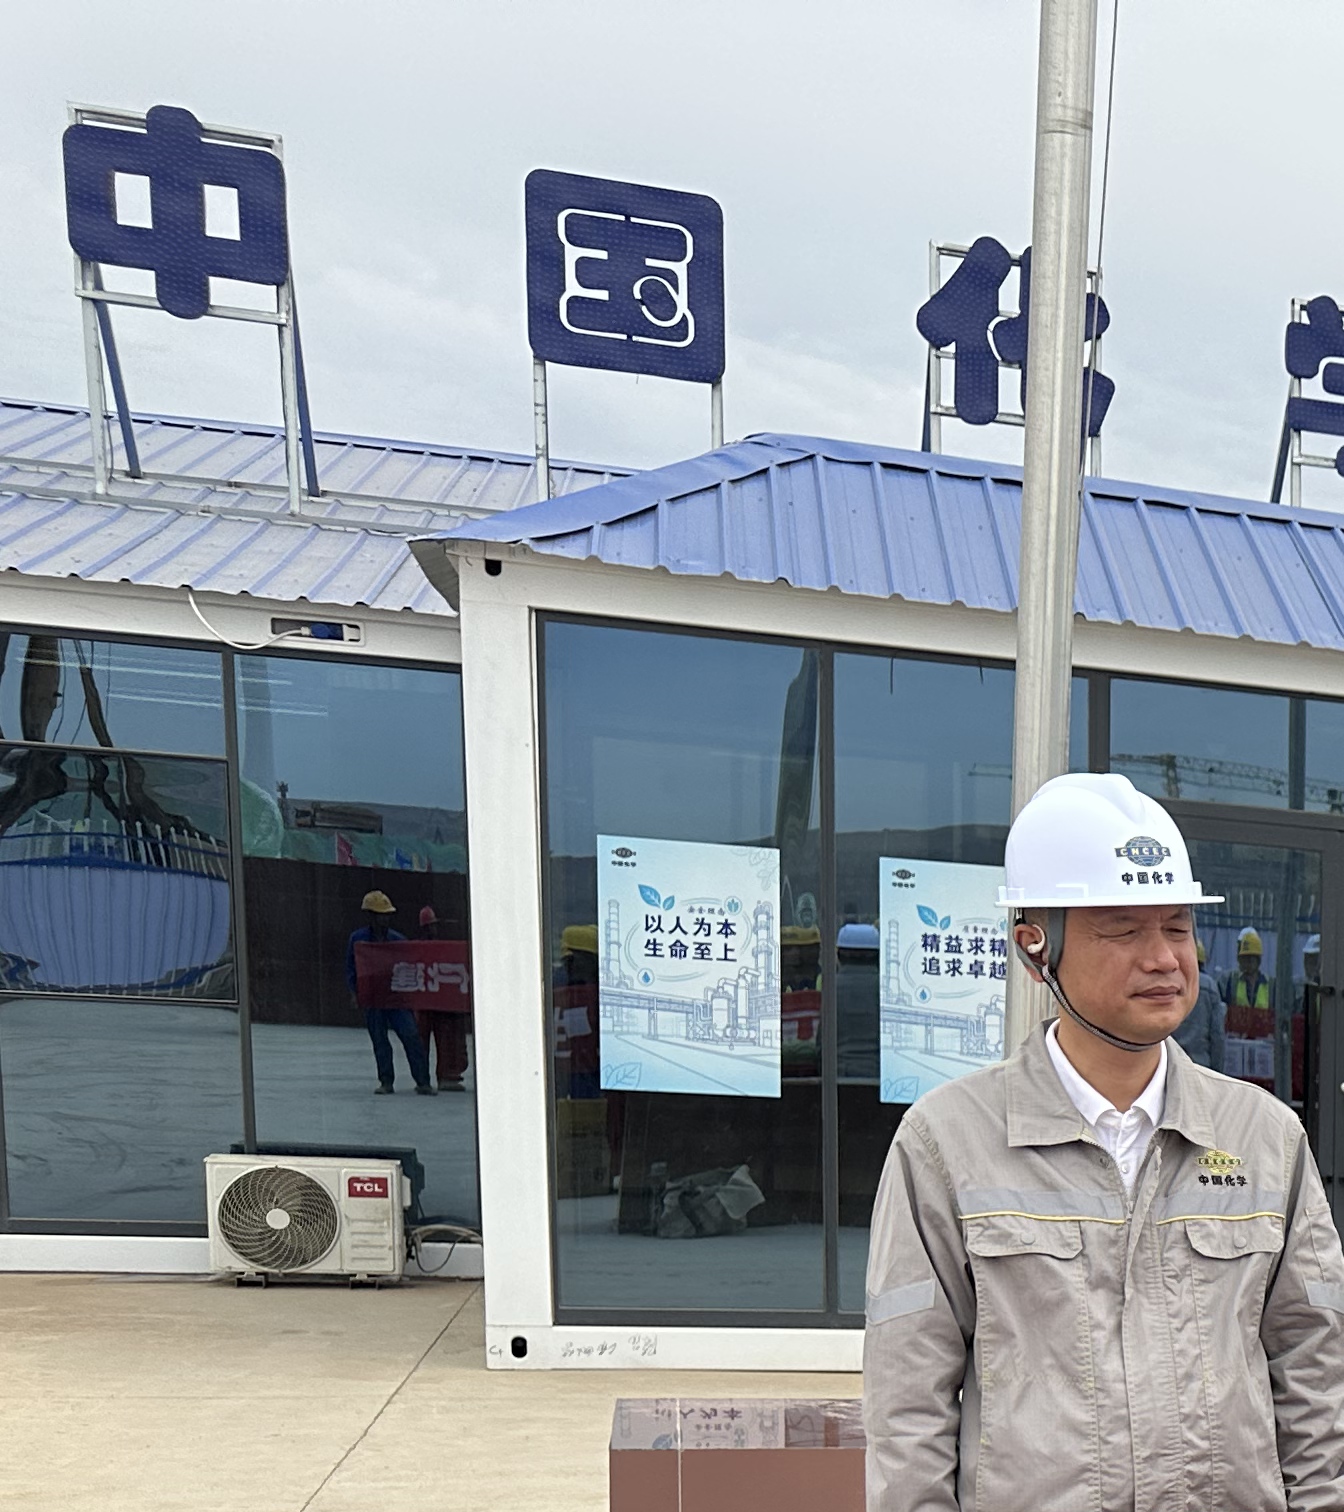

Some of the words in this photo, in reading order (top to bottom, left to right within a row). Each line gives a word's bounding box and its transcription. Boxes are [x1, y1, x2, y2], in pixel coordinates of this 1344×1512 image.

[1121, 871, 1174, 885] 中国化学
[644, 914, 737, 939] 以人为本
[644, 938, 737, 962] 生命至上
[921, 933, 1007, 957] 精益求精
[921, 957, 1007, 980] 追求卓越
[353, 1182, 383, 1193] TCL
[1198, 1174, 1247, 1186] 中国化学
